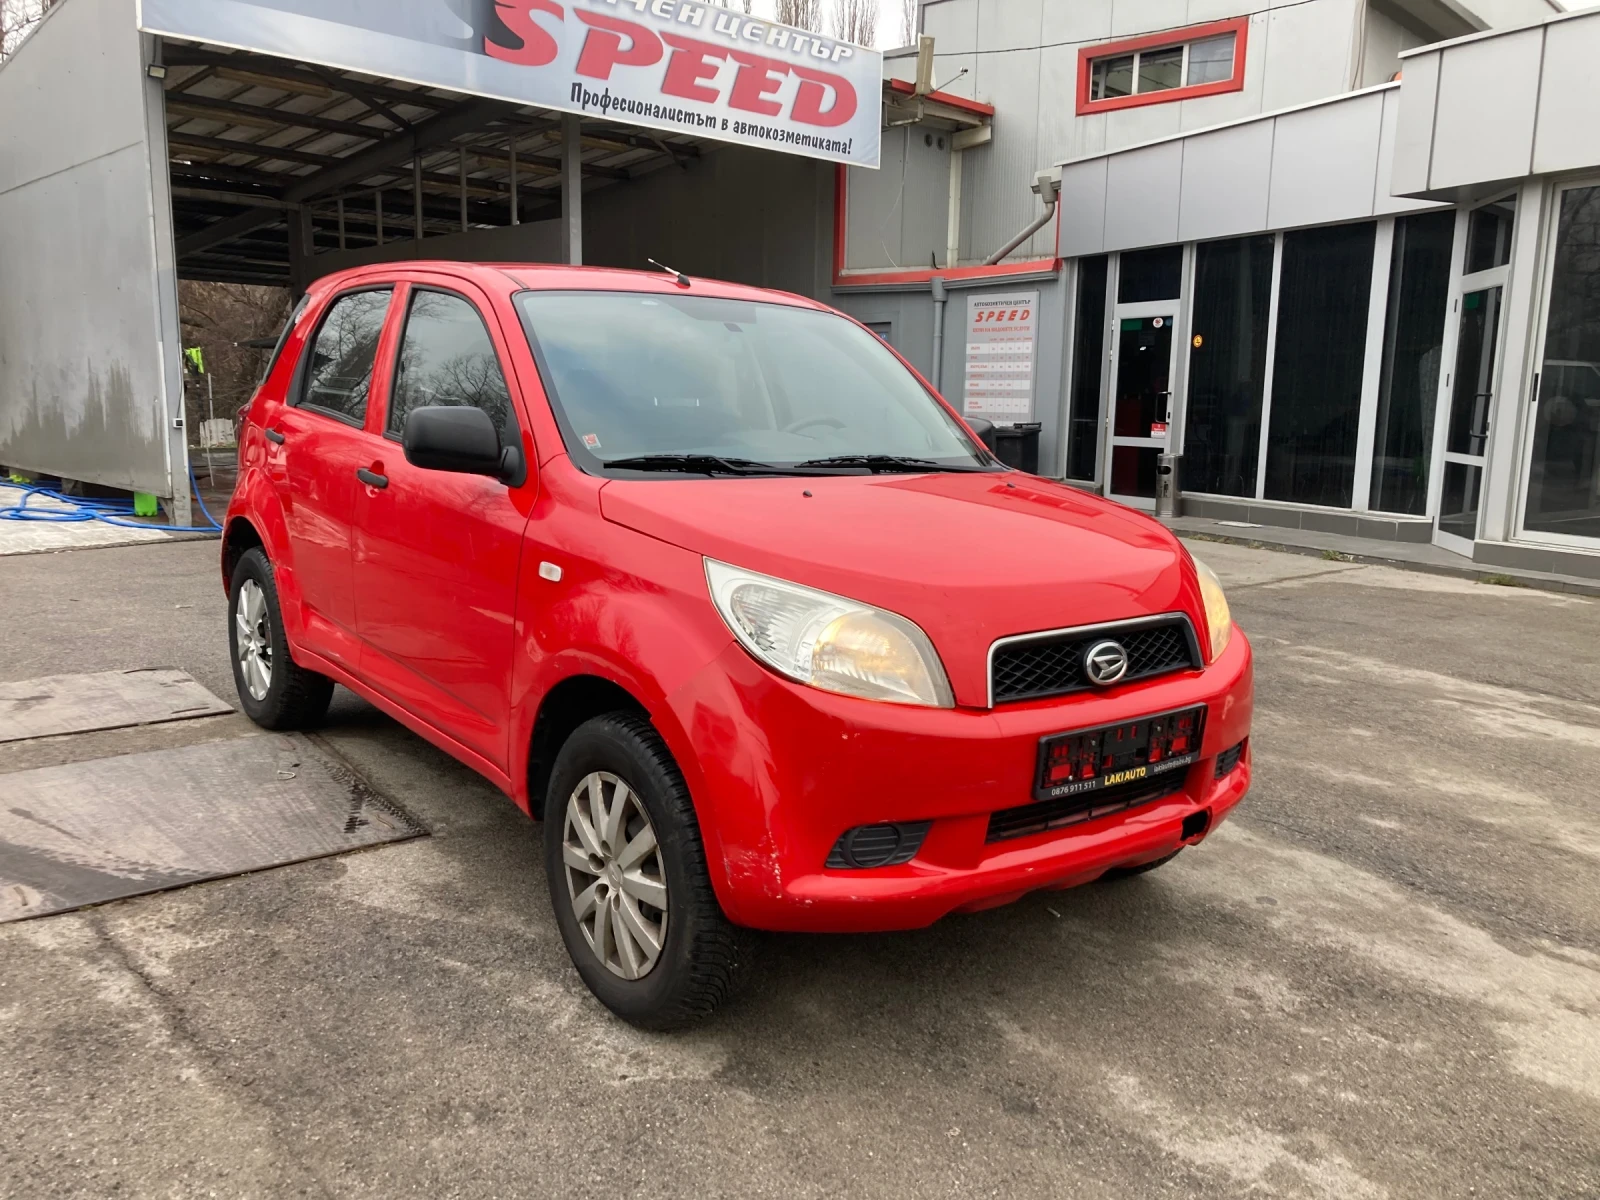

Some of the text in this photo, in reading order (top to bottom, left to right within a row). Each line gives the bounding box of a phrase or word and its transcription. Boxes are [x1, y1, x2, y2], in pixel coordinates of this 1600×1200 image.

[713, 17, 853, 63] ЦЕНТЪР
[484, 0, 858, 127] SPEED
[571, 82, 853, 155] Професионалистът в автокозметиката!
[975, 309, 1030, 322] SPEED
[1051, 786, 1069, 796] 0876
[1069, 783, 1082, 793] 911
[1084, 780, 1096, 790] 511
